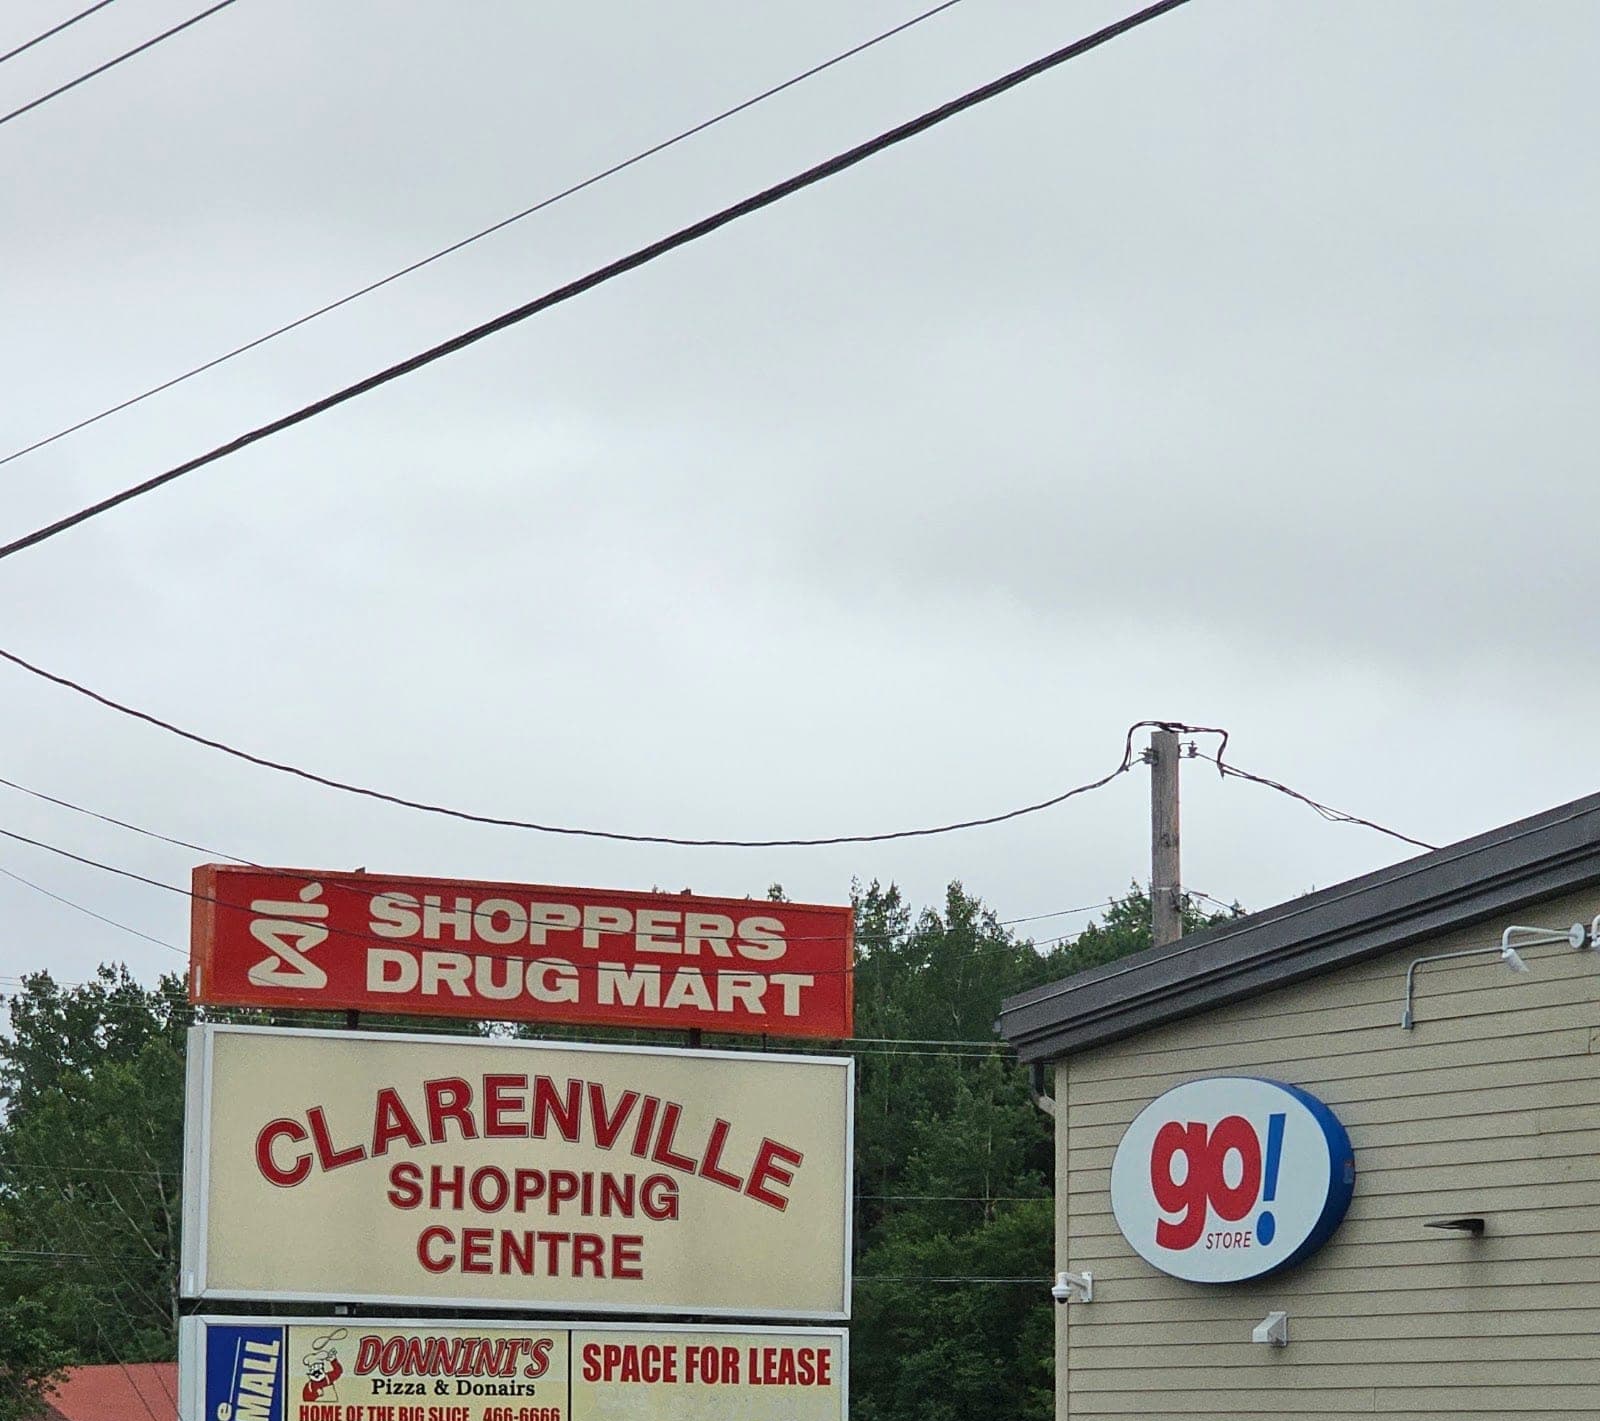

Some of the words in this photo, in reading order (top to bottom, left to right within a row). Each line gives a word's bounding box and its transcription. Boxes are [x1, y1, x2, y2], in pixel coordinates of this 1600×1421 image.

[368, 891, 787, 961] SHOPPERS
[366, 949, 579, 1003] DRUG
[597, 961, 814, 1016] MART
[255, 1073, 803, 1212] CLARENVILLE
[387, 1162, 679, 1221] SHOPPING
[1150, 1113, 1286, 1250] go!
[416, 1225, 644, 1280] CENTRE
[1206, 1231, 1252, 1250] STORE
[354, 1335, 553, 1378] DONNINI'S
[582, 1344, 677, 1383] SPACE
[685, 1346, 740, 1384] FOR
[749, 1348, 831, 1385] LEASE
[371, 1380, 426, 1396] Pizza
[435, 1380, 449, 1395] &
[456, 1379, 535, 1397] Donairs
